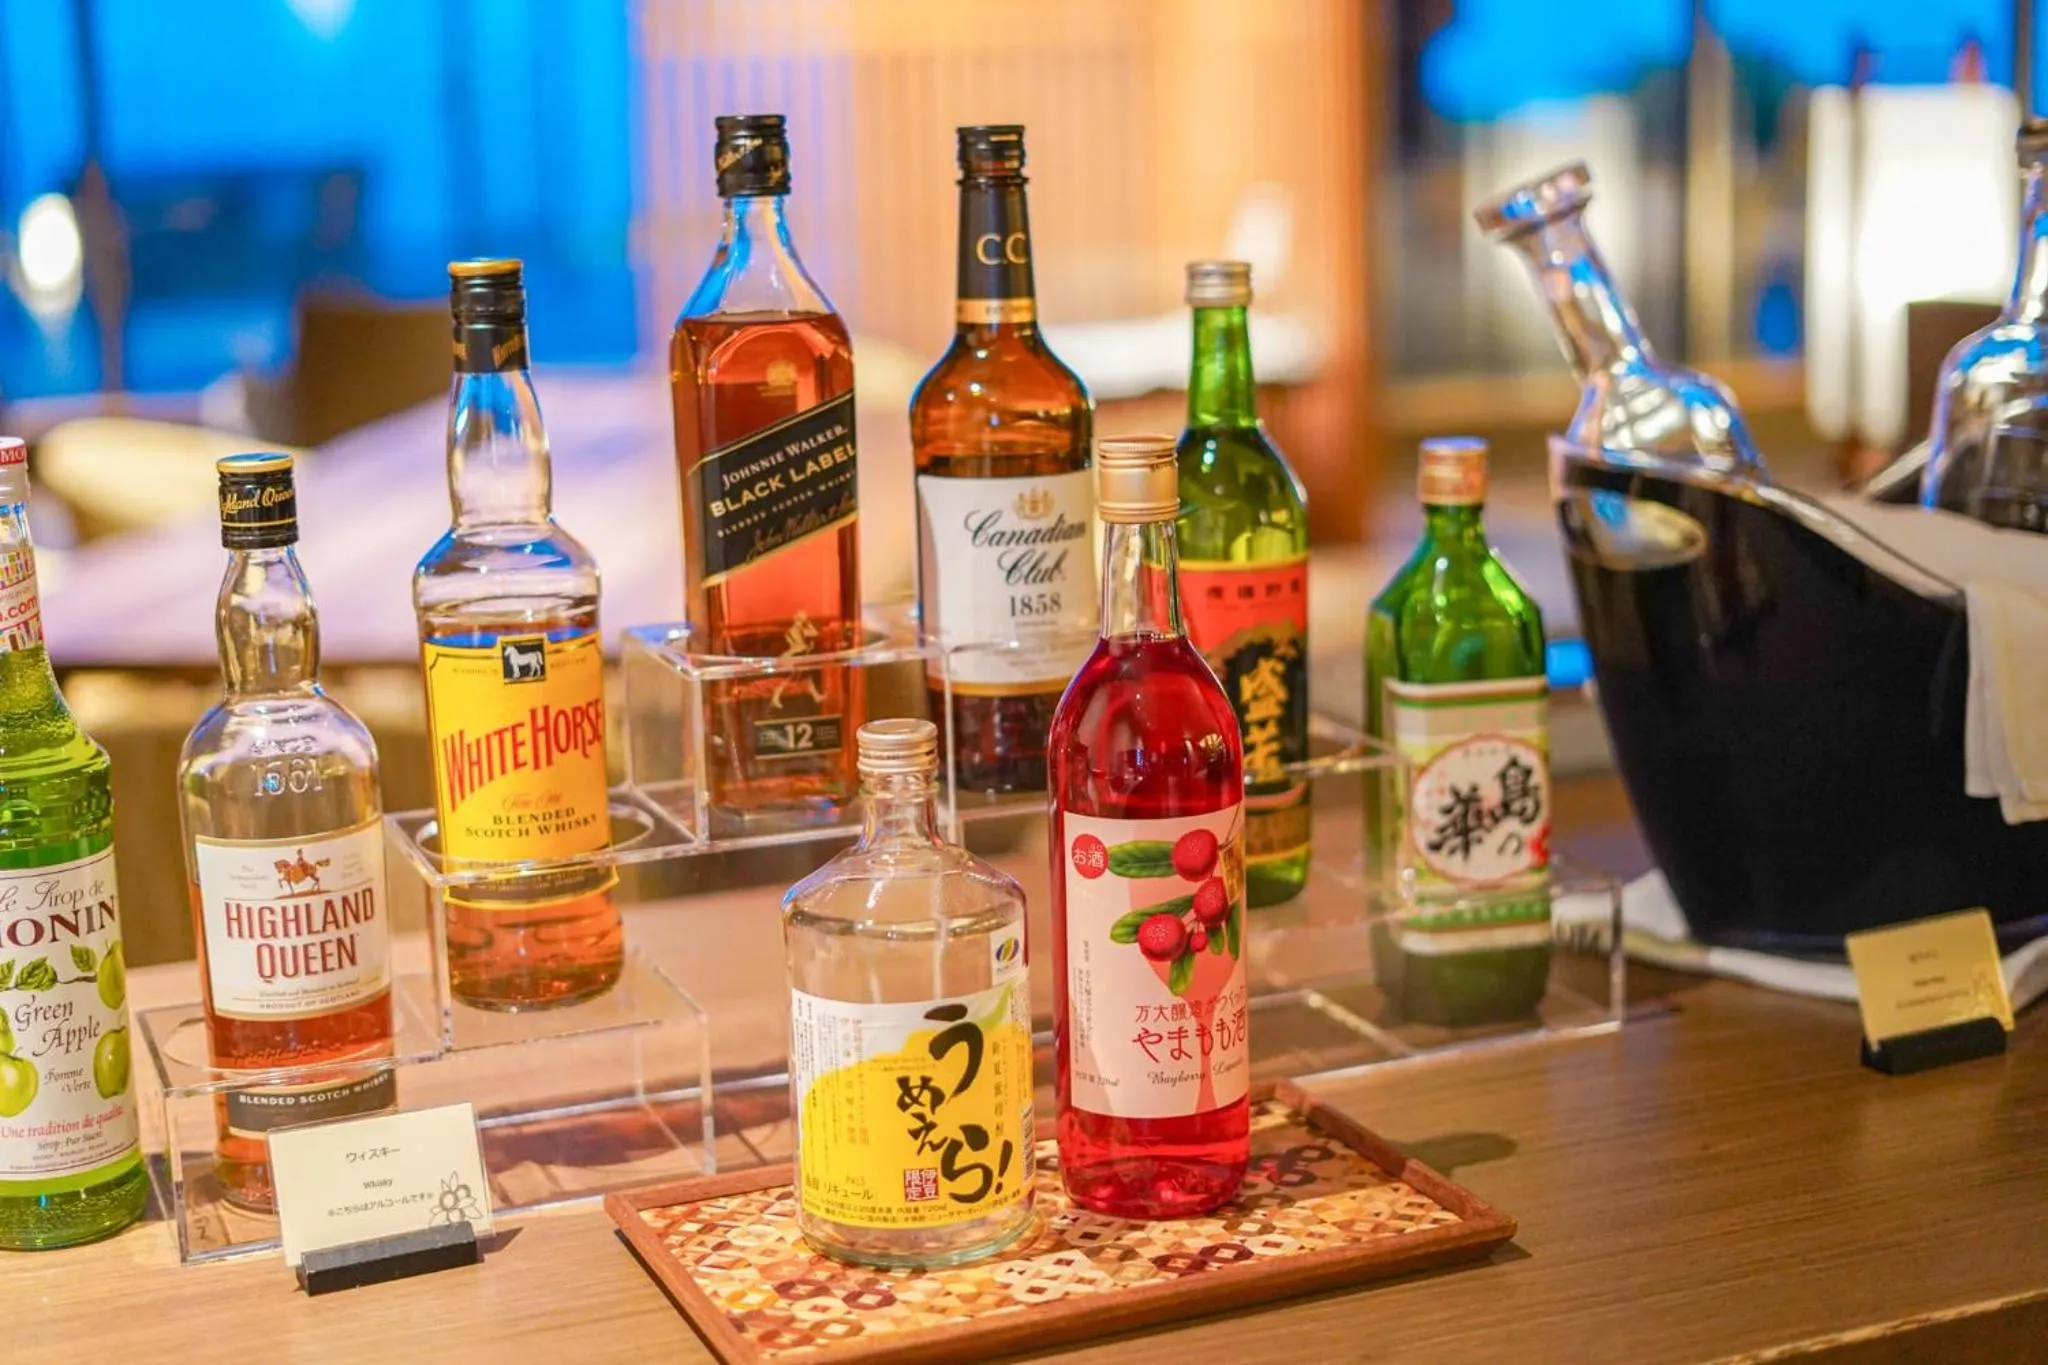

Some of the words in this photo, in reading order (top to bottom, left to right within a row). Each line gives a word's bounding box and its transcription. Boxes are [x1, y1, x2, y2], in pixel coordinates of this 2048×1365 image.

[709, 473, 786, 518] BLACK
[789, 442, 857, 483] LABEL
[721, 451, 786, 491] JOHNNIE
[963, 509, 1087, 549] Canadian
[1009, 592, 1062, 617] 1858
[784, 723, 814, 749] 12
[442, 721, 528, 814] WHITE
[529, 698, 603, 773] HORSE
[466, 827, 530, 839] SCOTCH
[538, 813, 597, 836] WHISKY
[493, 807, 575, 825] BLENDED
[25, 879, 84, 913] Sirop
[224, 887, 375, 940] HIGHLAND
[0, 895, 116, 948] ONIN
[256, 933, 358, 985] QUEEN
[15, 994, 74, 1032] Green
[32, 1014, 101, 1057] Apple
[1132, 1006, 1247, 1064] やまもも酒
[239, 1094, 295, 1105] BLENDED
[299, 1089, 349, 1104] SCOTCH
[27, 1118, 80, 1137] tradition
[345, 1146, 401, 1164] ウィスキー
[823, 1180, 874, 1200] リキュール
